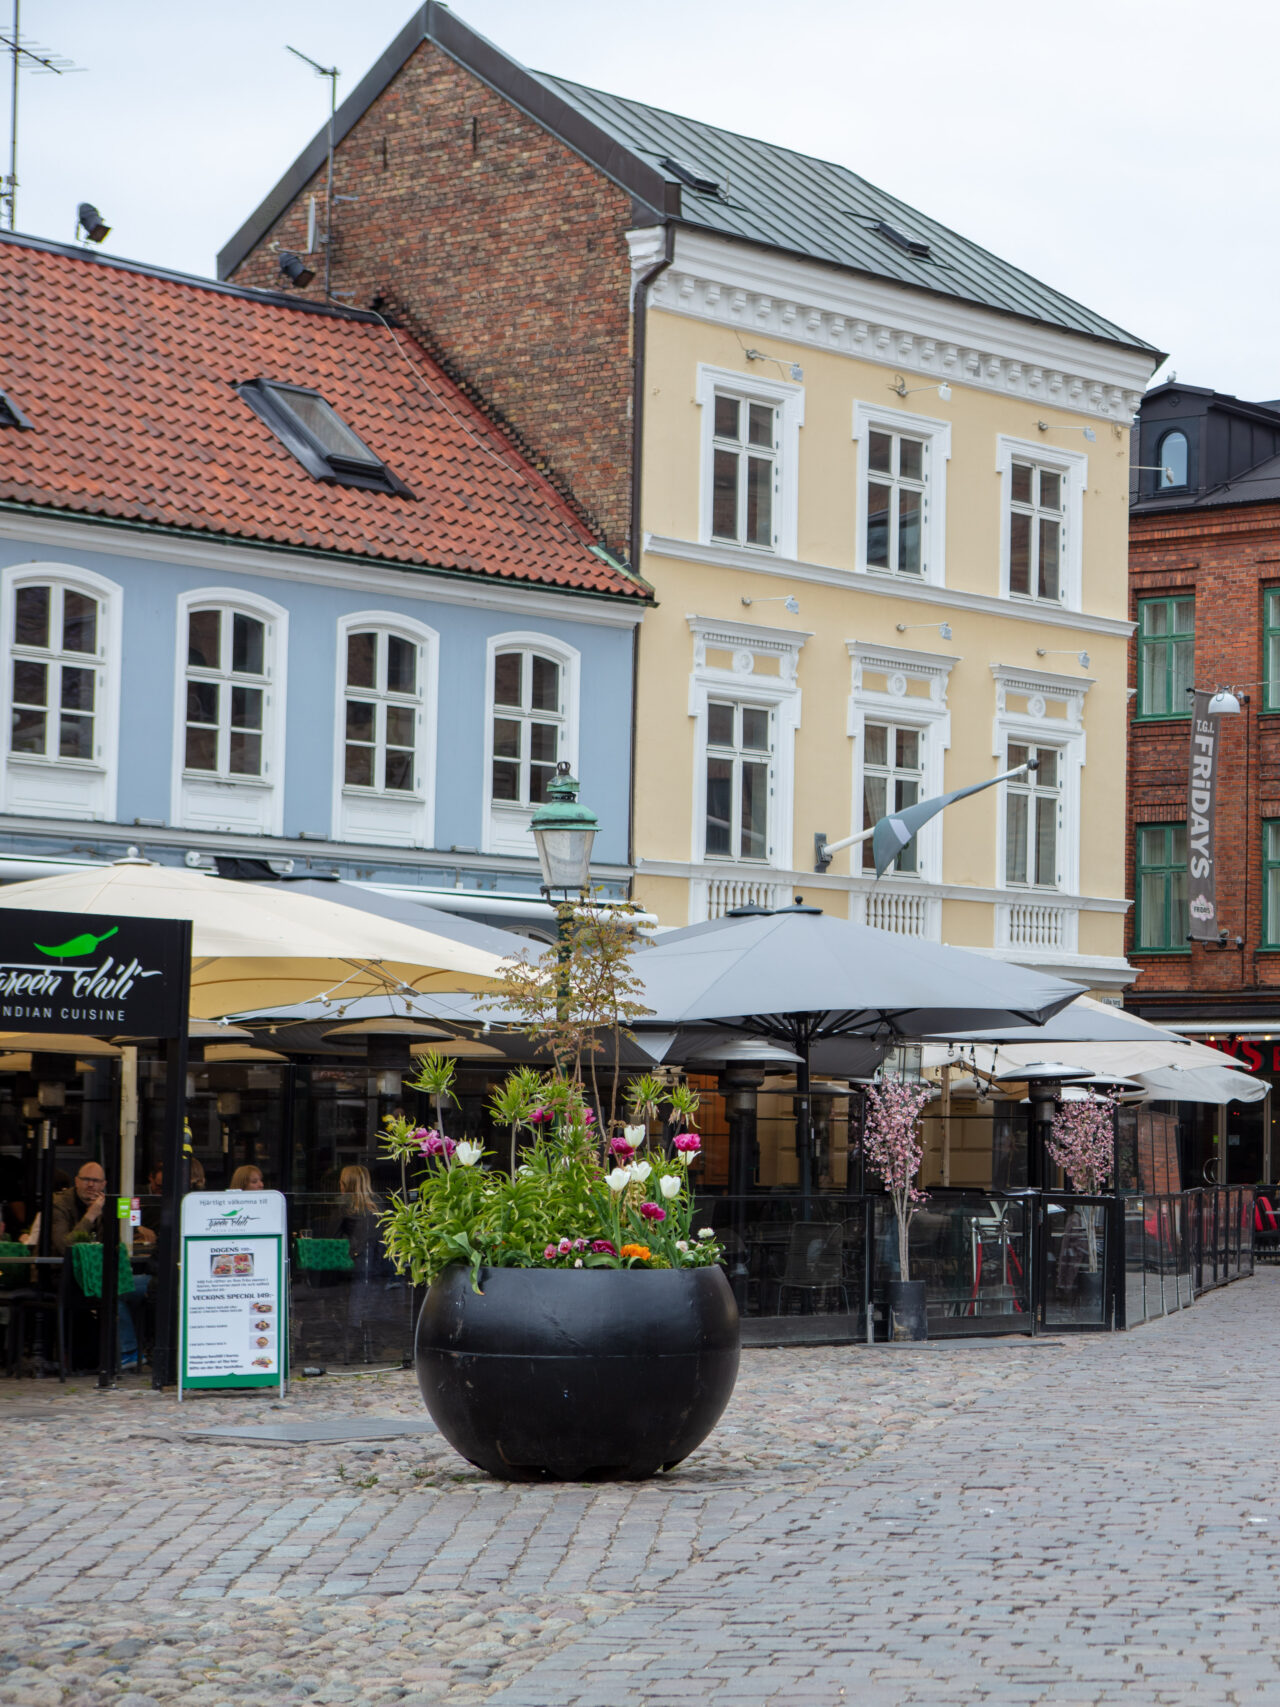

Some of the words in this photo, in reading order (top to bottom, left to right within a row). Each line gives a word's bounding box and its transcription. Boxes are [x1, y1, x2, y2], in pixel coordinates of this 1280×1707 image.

[1196, 719, 1215, 734] T.G.I.
[2, 1006, 52, 1018] NDIAN
[61, 1008, 126, 1021] CUISINE
